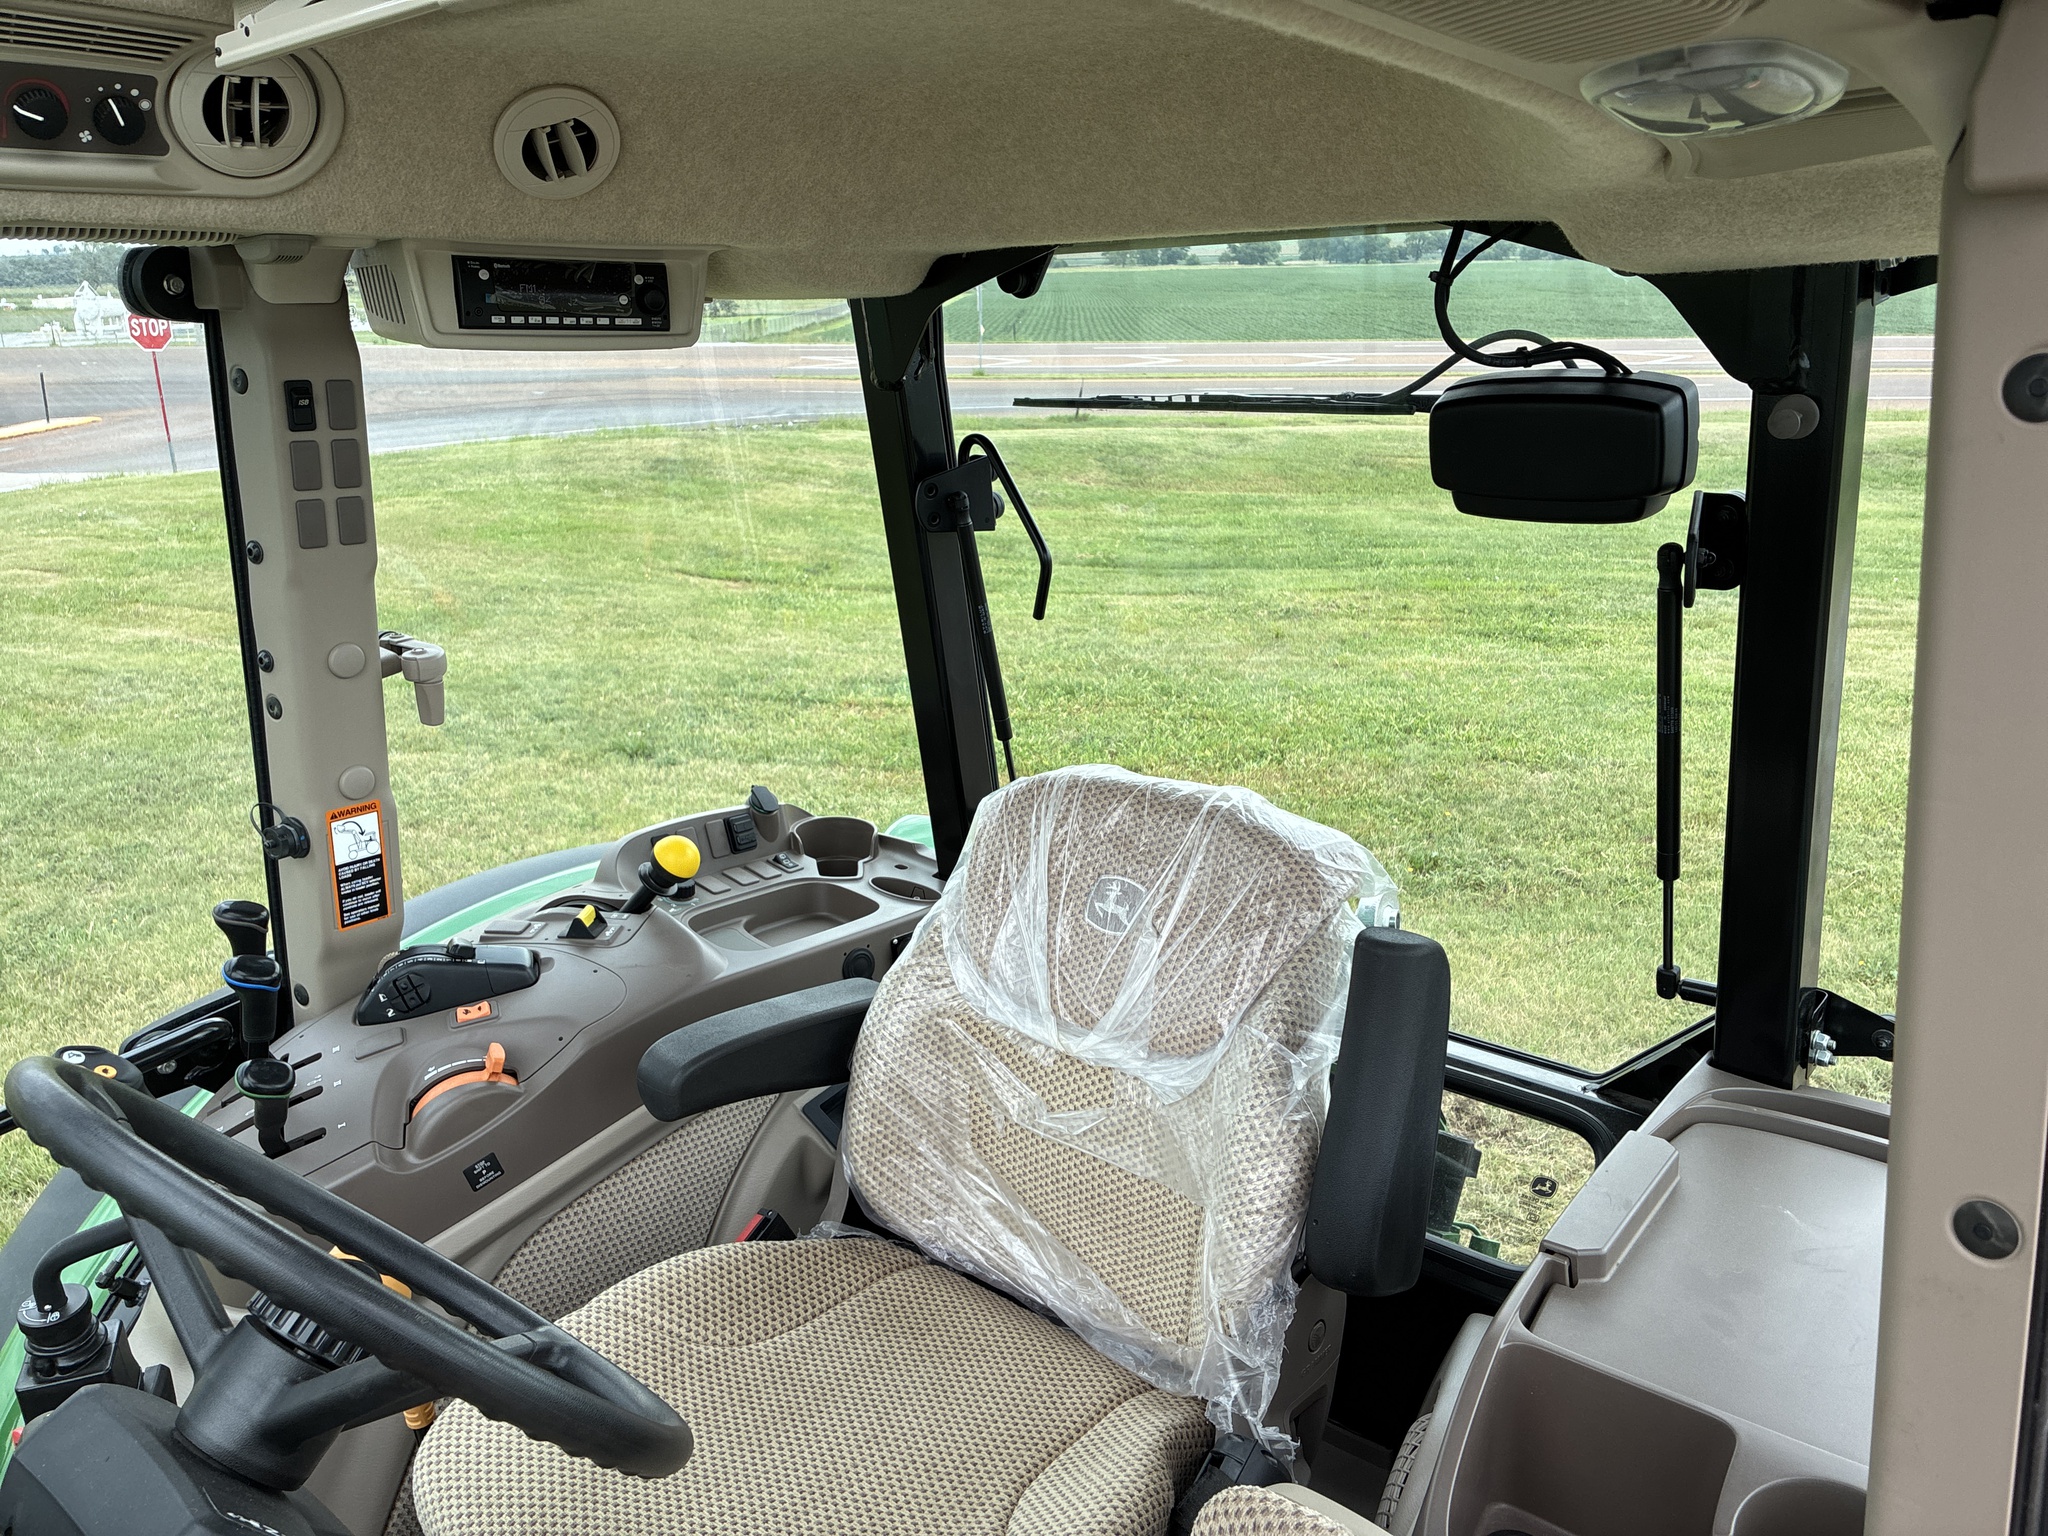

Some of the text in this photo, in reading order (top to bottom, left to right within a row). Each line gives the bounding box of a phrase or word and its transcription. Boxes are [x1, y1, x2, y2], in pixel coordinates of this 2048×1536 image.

[131, 318, 168, 336] STOP
[337, 802, 377, 818] WARNING
[386, 1008, 396, 1017] 2
